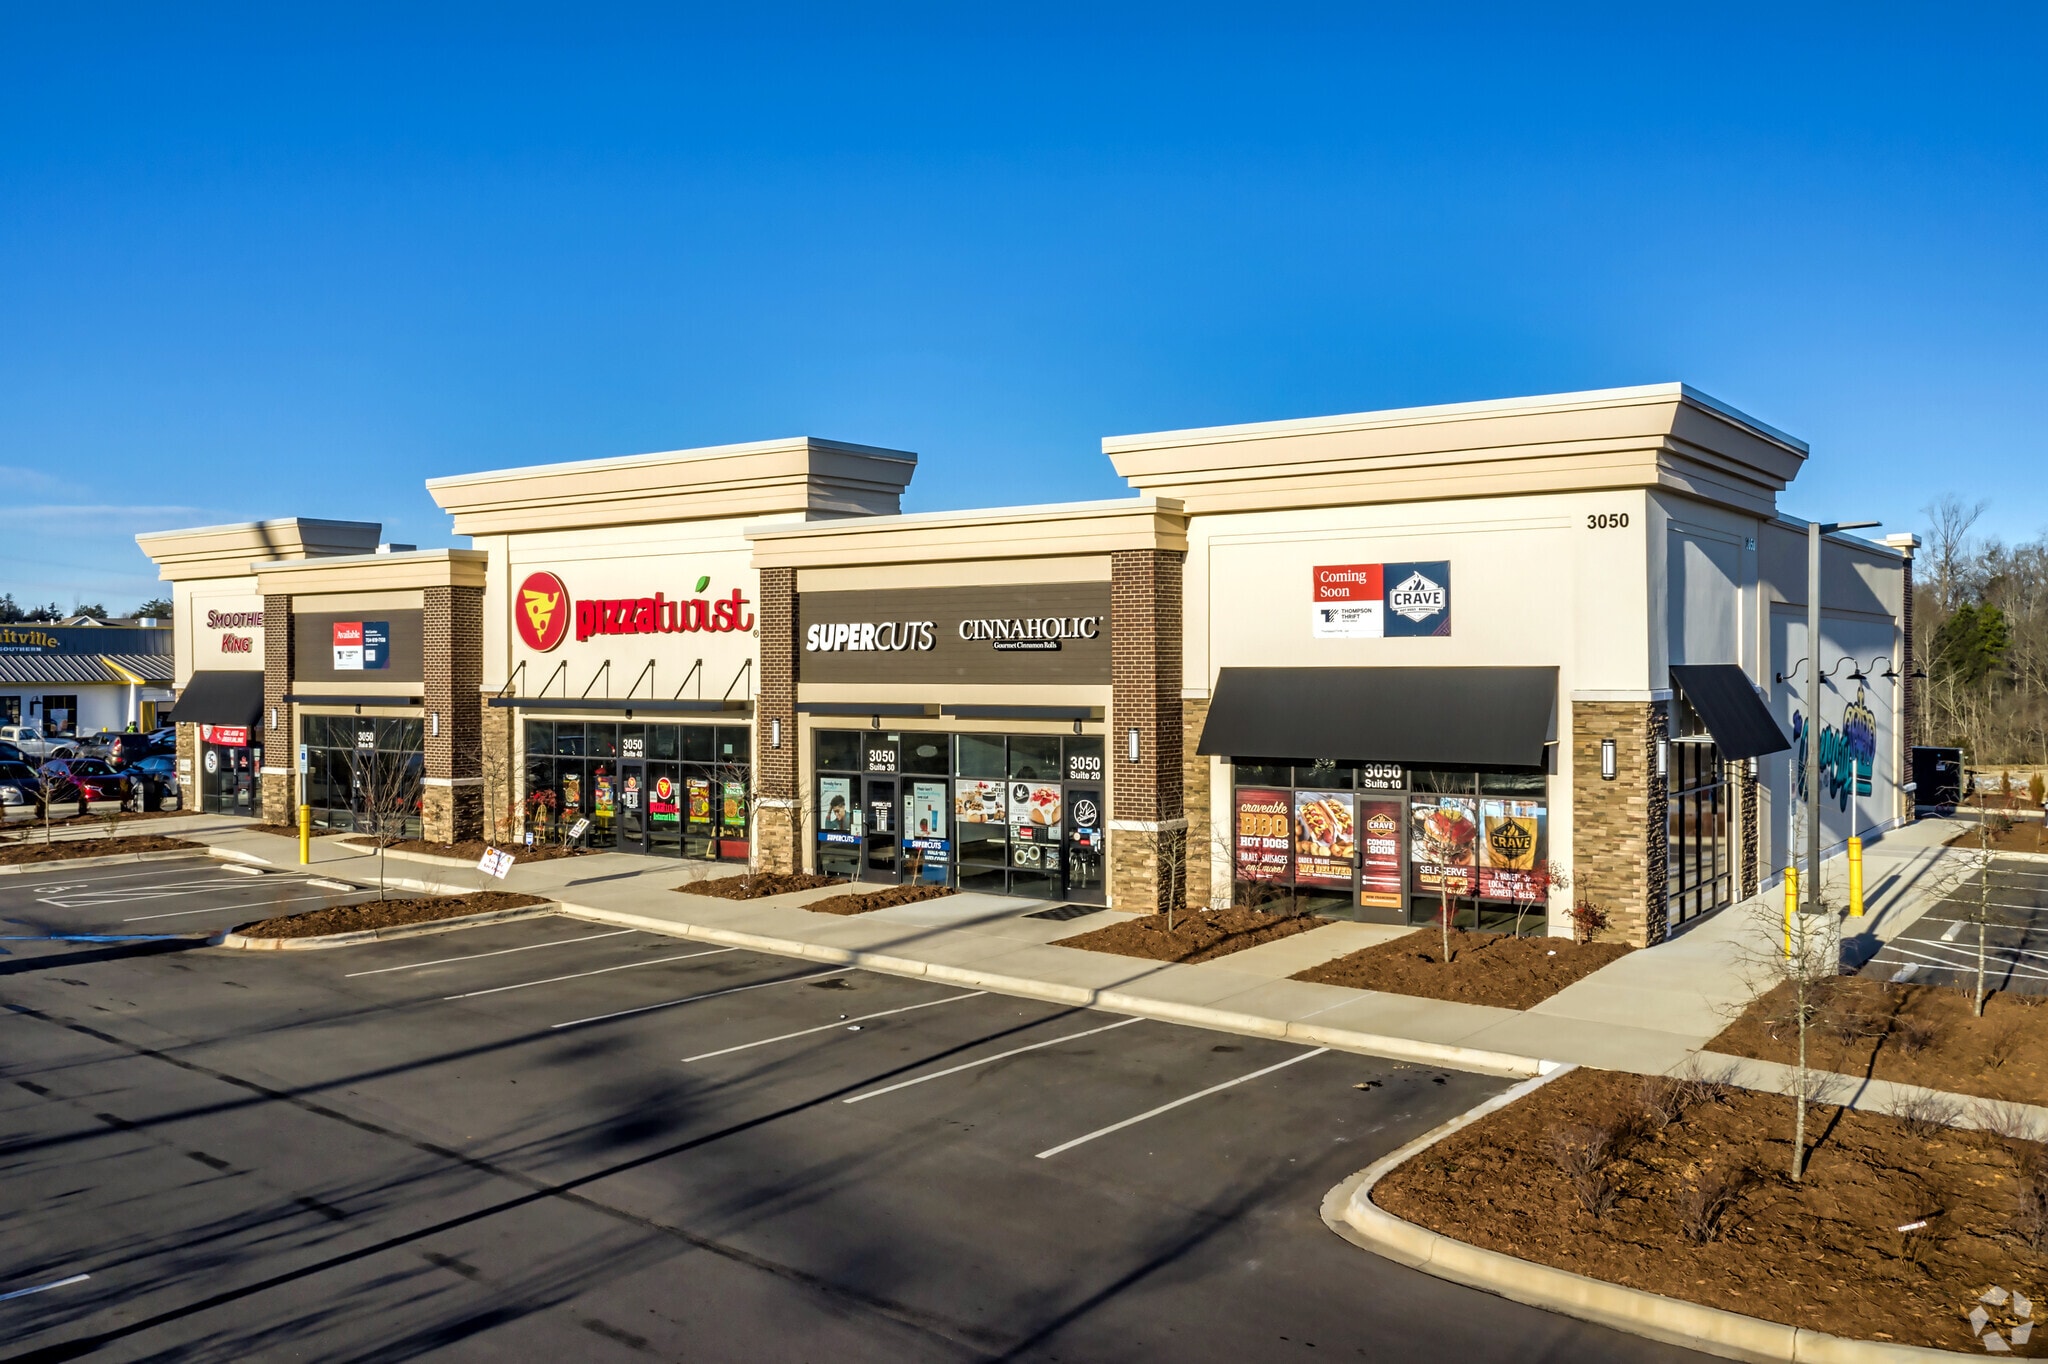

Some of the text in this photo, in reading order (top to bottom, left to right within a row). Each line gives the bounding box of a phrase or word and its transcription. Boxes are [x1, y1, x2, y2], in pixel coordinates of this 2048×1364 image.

[1587, 513, 1629, 529] 3050
[1320, 570, 1366, 584] Coming
[1320, 586, 1350, 598] Soon
[1394, 592, 1441, 605] CRAVE
[207, 609, 263, 628] SMOOTHIE
[575, 586, 755, 642] pizzatwist
[959, 616, 1098, 640] CINNAHOLIC
[337, 630, 361, 639] Available
[806, 621, 935, 651] SUPERCUTS
[994, 641, 1016, 649] Gourmet
[1017, 641, 1043, 649] Cinnamon
[357, 731, 374, 742] 3050
[623, 739, 643, 750] 3050
[869, 749, 895, 763] 3050
[869, 763, 895, 772] Suite 30
[1070, 756, 1101, 771] 3050
[1070, 771, 1101, 780] Suite 20
[1365, 763, 1402, 779] 3050
[1365, 779, 1402, 789] Suite 10
[1241, 801, 1288, 815] craveable
[1239, 812, 1290, 838] BBQ
[1369, 821, 1394, 830] CRAVE
[826, 833, 855, 843] SUPERCUTS
[1240, 836, 1289, 850] HOT DOGS
[1366, 838, 1396, 846] COMING
[1492, 836, 1531, 849] CRAVE
[912, 840, 942, 850] SUPERCUTS
[1370, 845, 1396, 855] SOON
[1261, 853, 1288, 865] SAUSAGES
[1314, 857, 1330, 865] ONLINE
